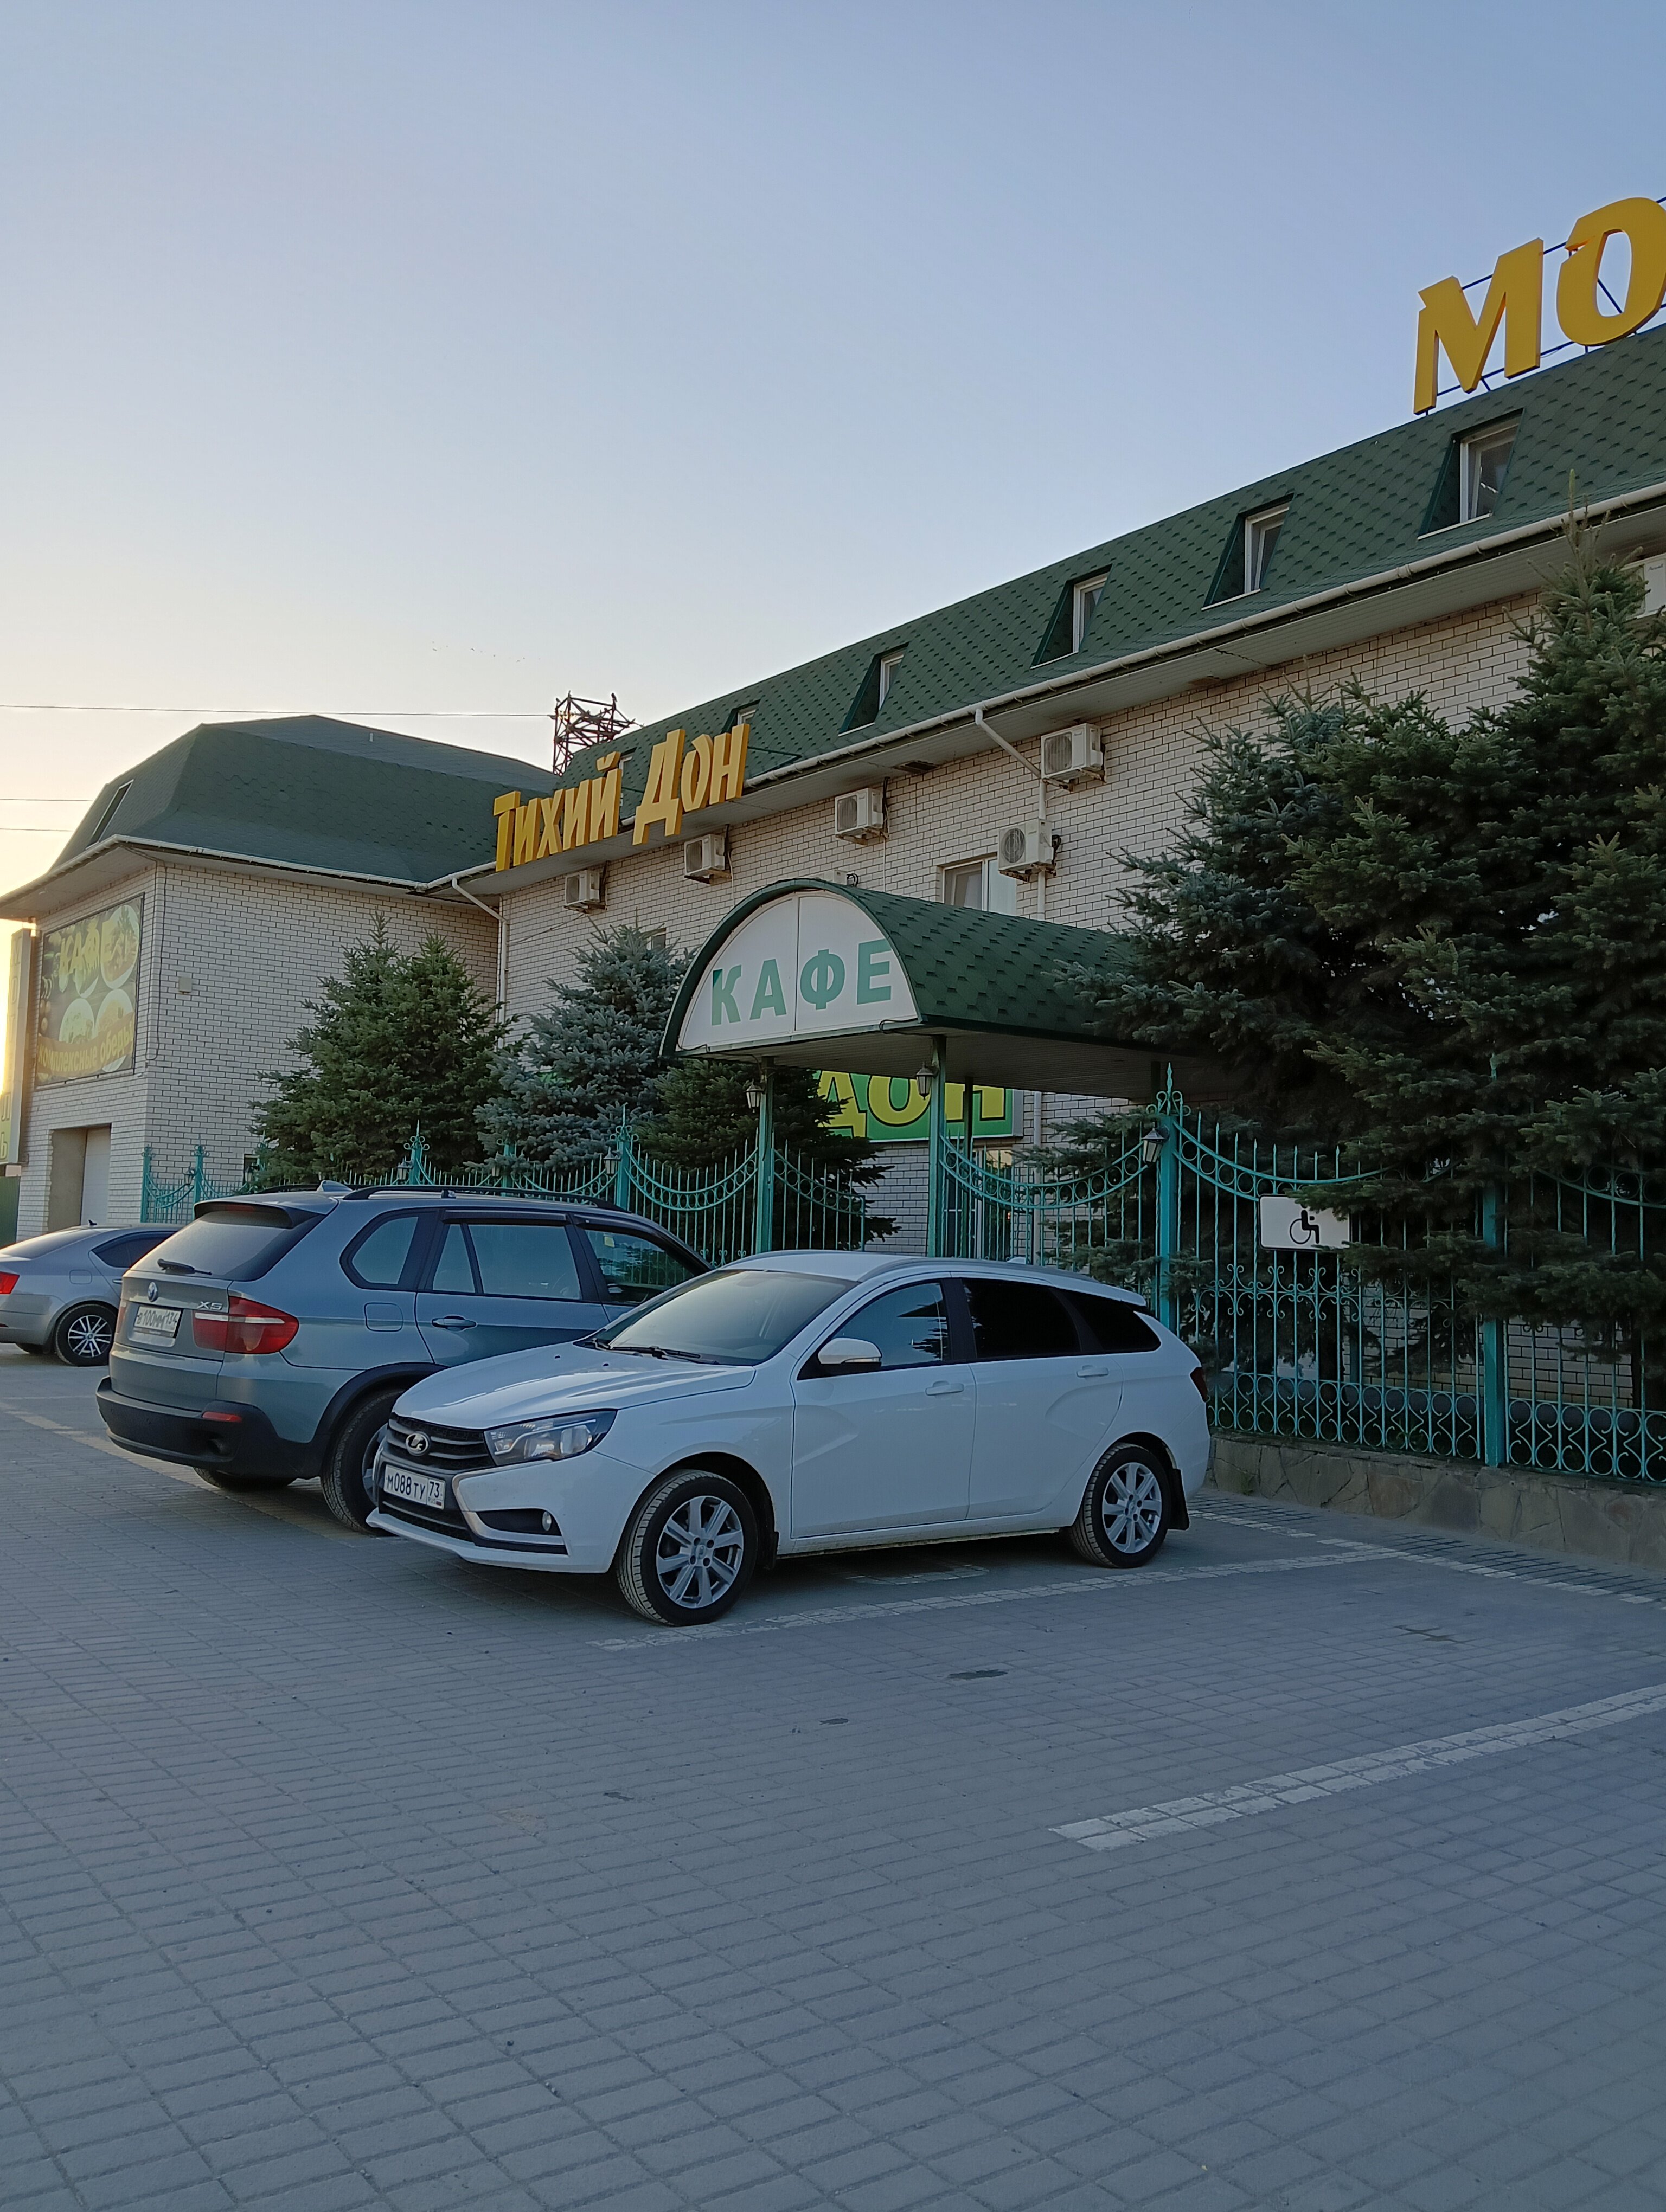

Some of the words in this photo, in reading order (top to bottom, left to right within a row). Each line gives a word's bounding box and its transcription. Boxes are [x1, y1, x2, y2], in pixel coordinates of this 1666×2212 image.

[1413, 197, 1666, 415] МО
[59, 919, 112, 976] КАФЕ
[712, 939, 892, 1026] КАФЕ
[0, 936, 21, 1160] МОТЛЬ
[39, 1043, 97, 1072] комплексные
[100, 1019, 134, 1063] обеды
[165, 1311, 178, 1325] 134
[197, 1301, 223, 1311] X5
[430, 1481, 440, 1498] 73
